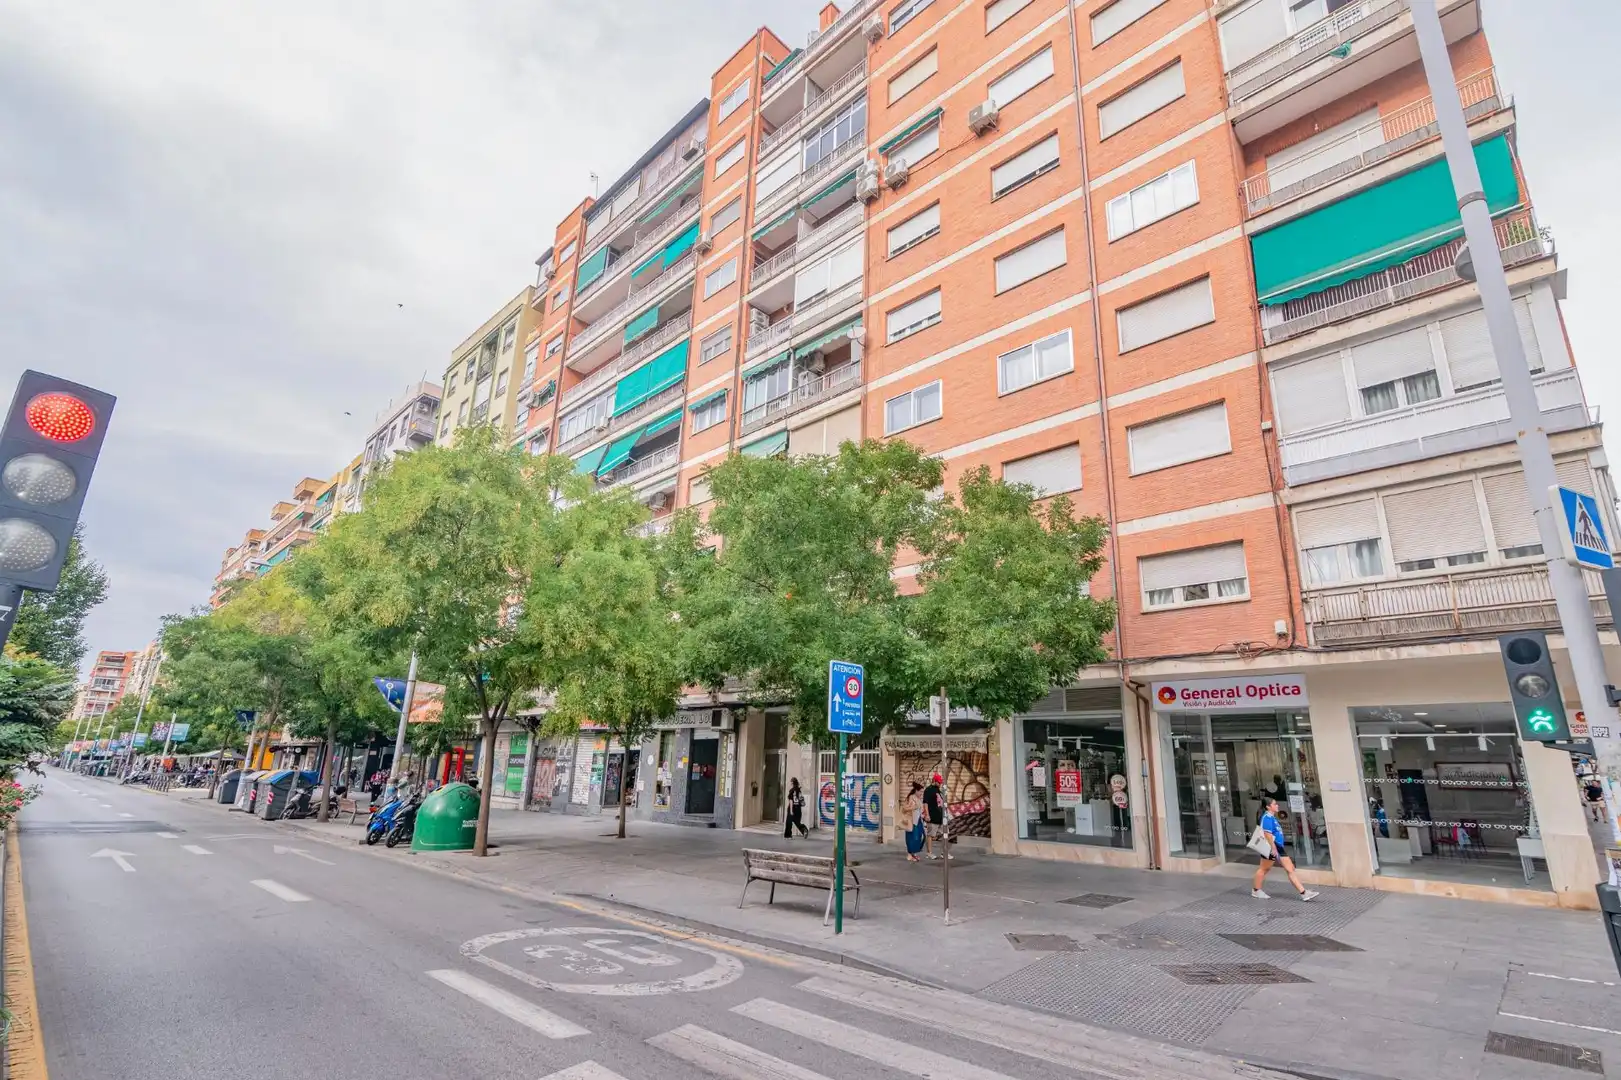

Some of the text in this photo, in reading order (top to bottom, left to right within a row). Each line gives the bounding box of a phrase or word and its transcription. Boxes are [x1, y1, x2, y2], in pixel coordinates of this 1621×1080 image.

[848, 683, 858, 691] 30
[1180, 682, 1301, 700] General Optica
